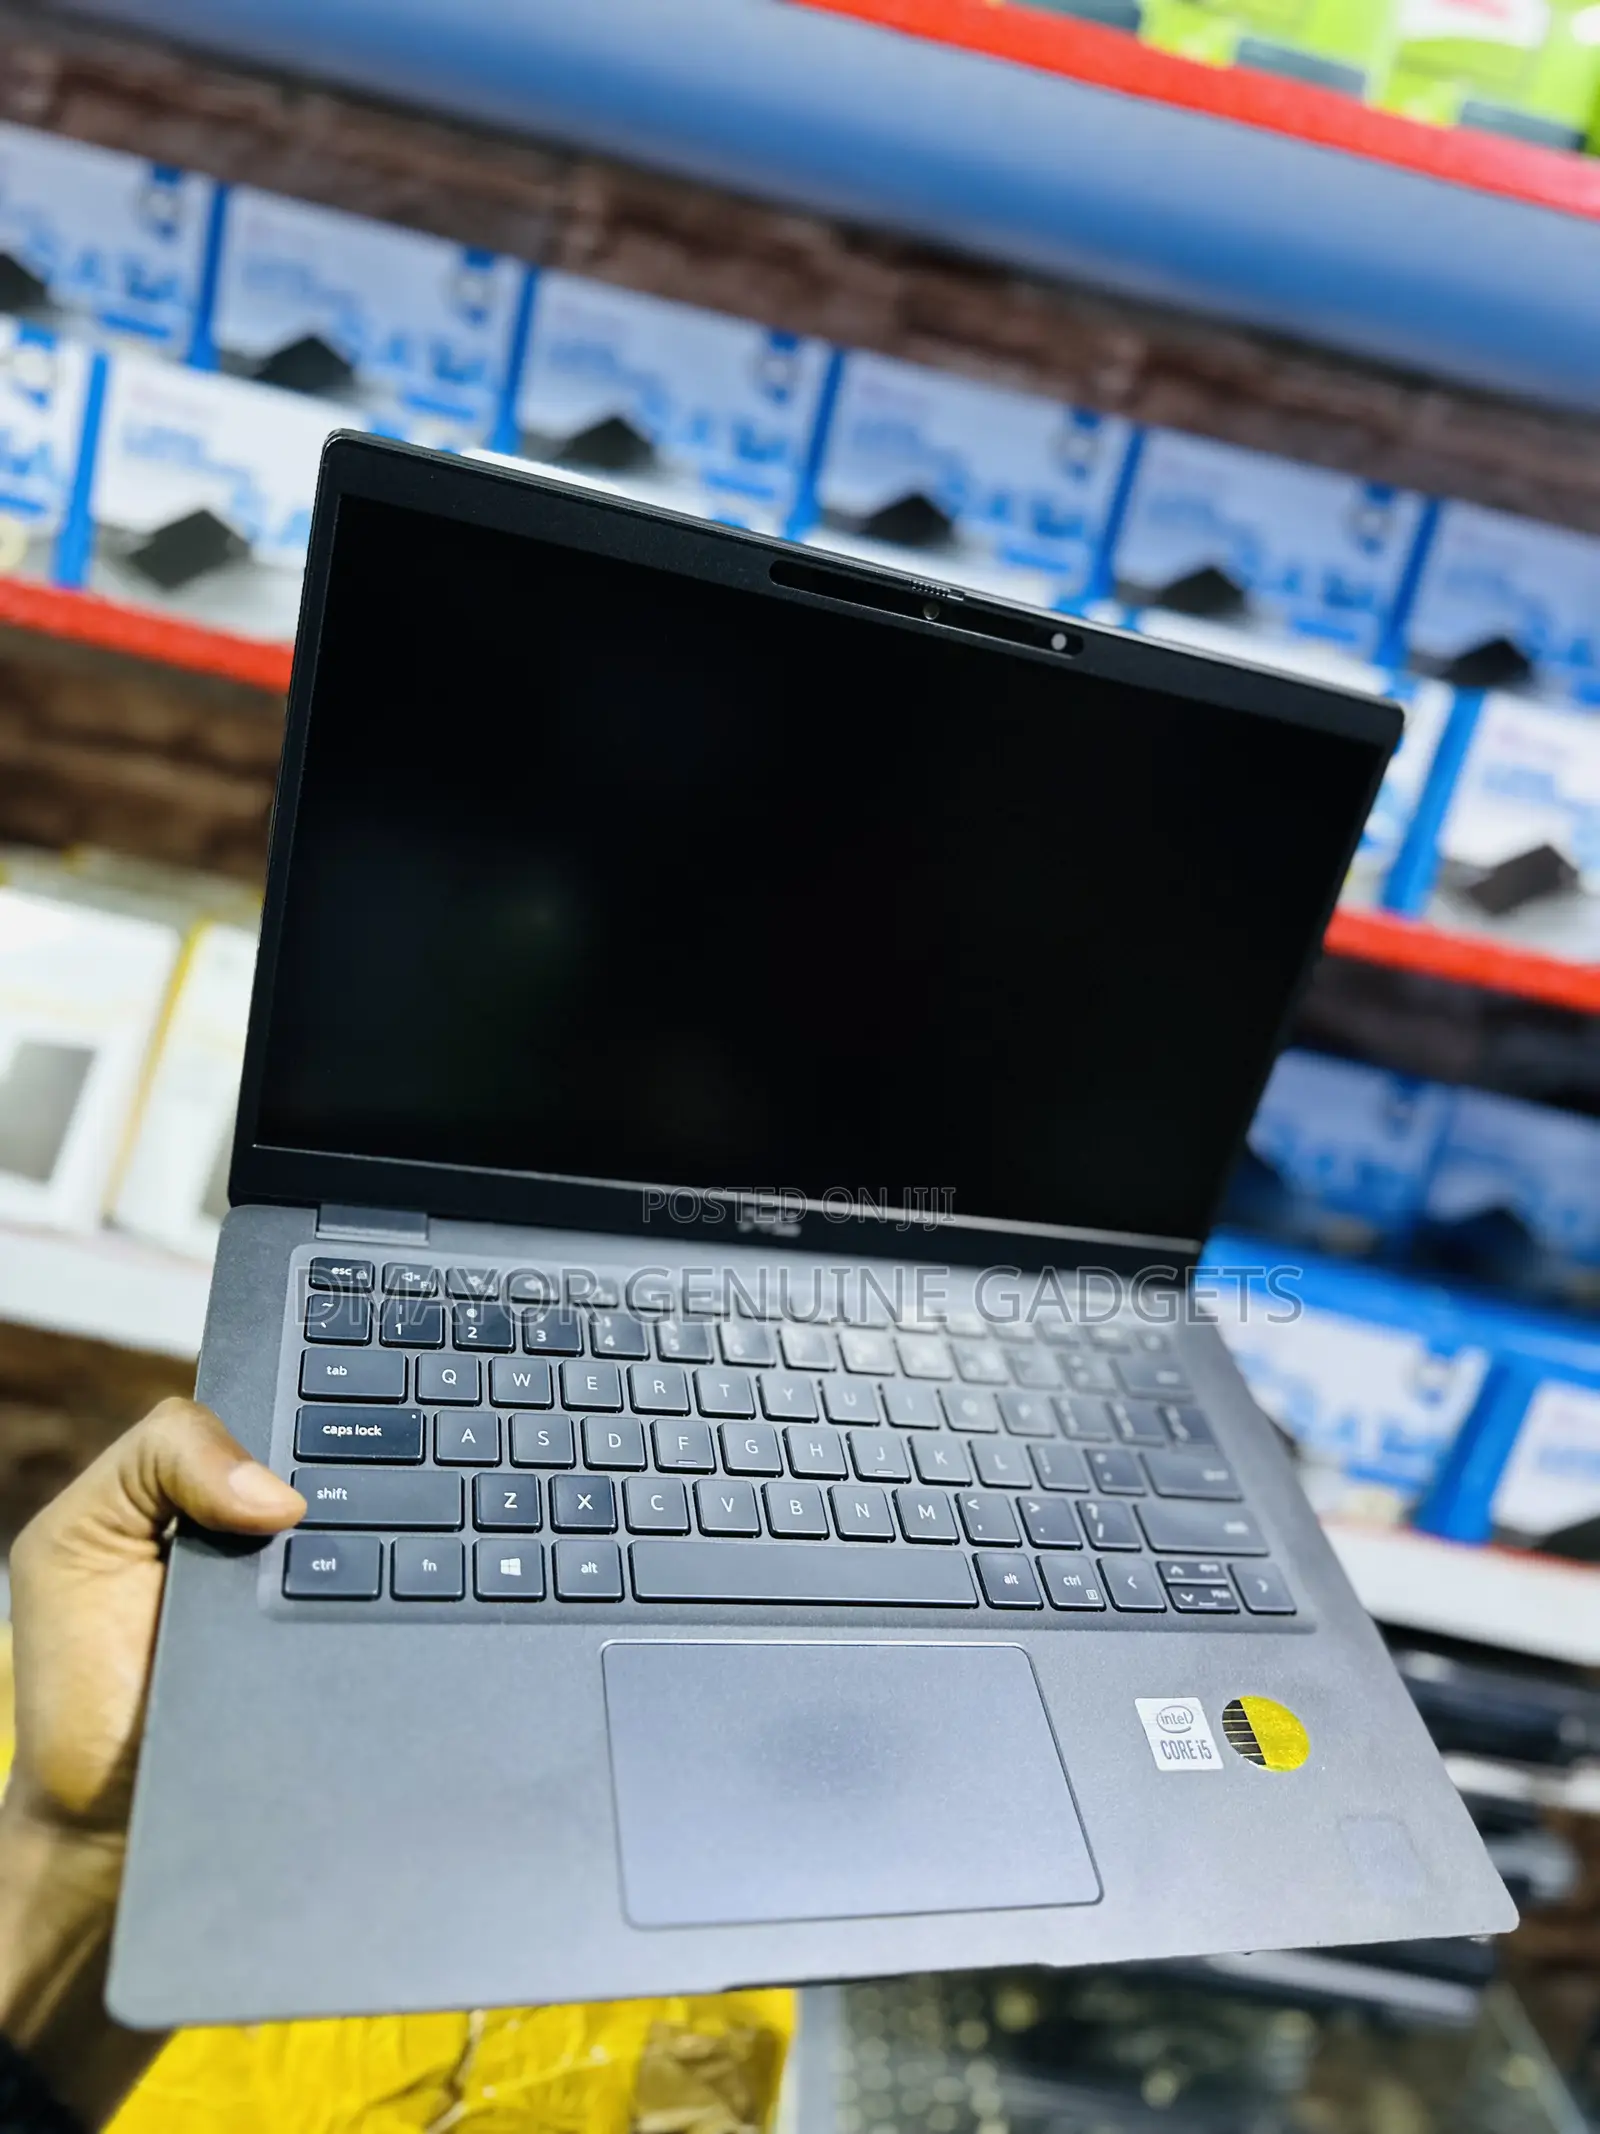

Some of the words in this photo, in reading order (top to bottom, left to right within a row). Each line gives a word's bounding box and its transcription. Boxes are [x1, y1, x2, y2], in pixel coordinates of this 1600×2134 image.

[331, 1266, 352, 1276] esc
[395, 1322, 402, 1336] 1
[467, 1326, 478, 1339] 2
[536, 1330, 547, 1342] 3
[326, 1365, 348, 1376] tab
[442, 1369, 457, 1385] Q
[512, 1373, 531, 1387] W
[587, 1377, 598, 1391] E
[653, 1381, 667, 1394] R
[718, 1384, 730, 1398] T
[783, 1387, 794, 1401] Y
[843, 1391, 857, 1406] U
[322, 1425, 351, 1437] caps
[355, 1424, 382, 1436] lock
[461, 1428, 476, 1443] A
[538, 1431, 549, 1446] S
[608, 1434, 621, 1448] D
[678, 1437, 689, 1450] F
[745, 1440, 758, 1454] G
[810, 1443, 823, 1458] H
[876, 1447, 886, 1461] J
[934, 1450, 948, 1465] K
[317, 1487, 347, 1501] shift
[504, 1492, 517, 1509] Z
[577, 1493, 594, 1510] X
[650, 1495, 664, 1511] C
[720, 1497, 734, 1512] V
[789, 1500, 803, 1515] B
[855, 1503, 870, 1518] N
[919, 1504, 936, 1520] M
[312, 1559, 336, 1572] ctrl
[422, 1559, 437, 1573] fn
[581, 1562, 598, 1574] alt
[1003, 1573, 1019, 1585] alt
[1063, 1574, 1082, 1587] ctrl
[1160, 1711, 1189, 1725] intel
[1160, 1739, 1198, 1760] CORE
[1195, 1739, 1212, 1760] i5
